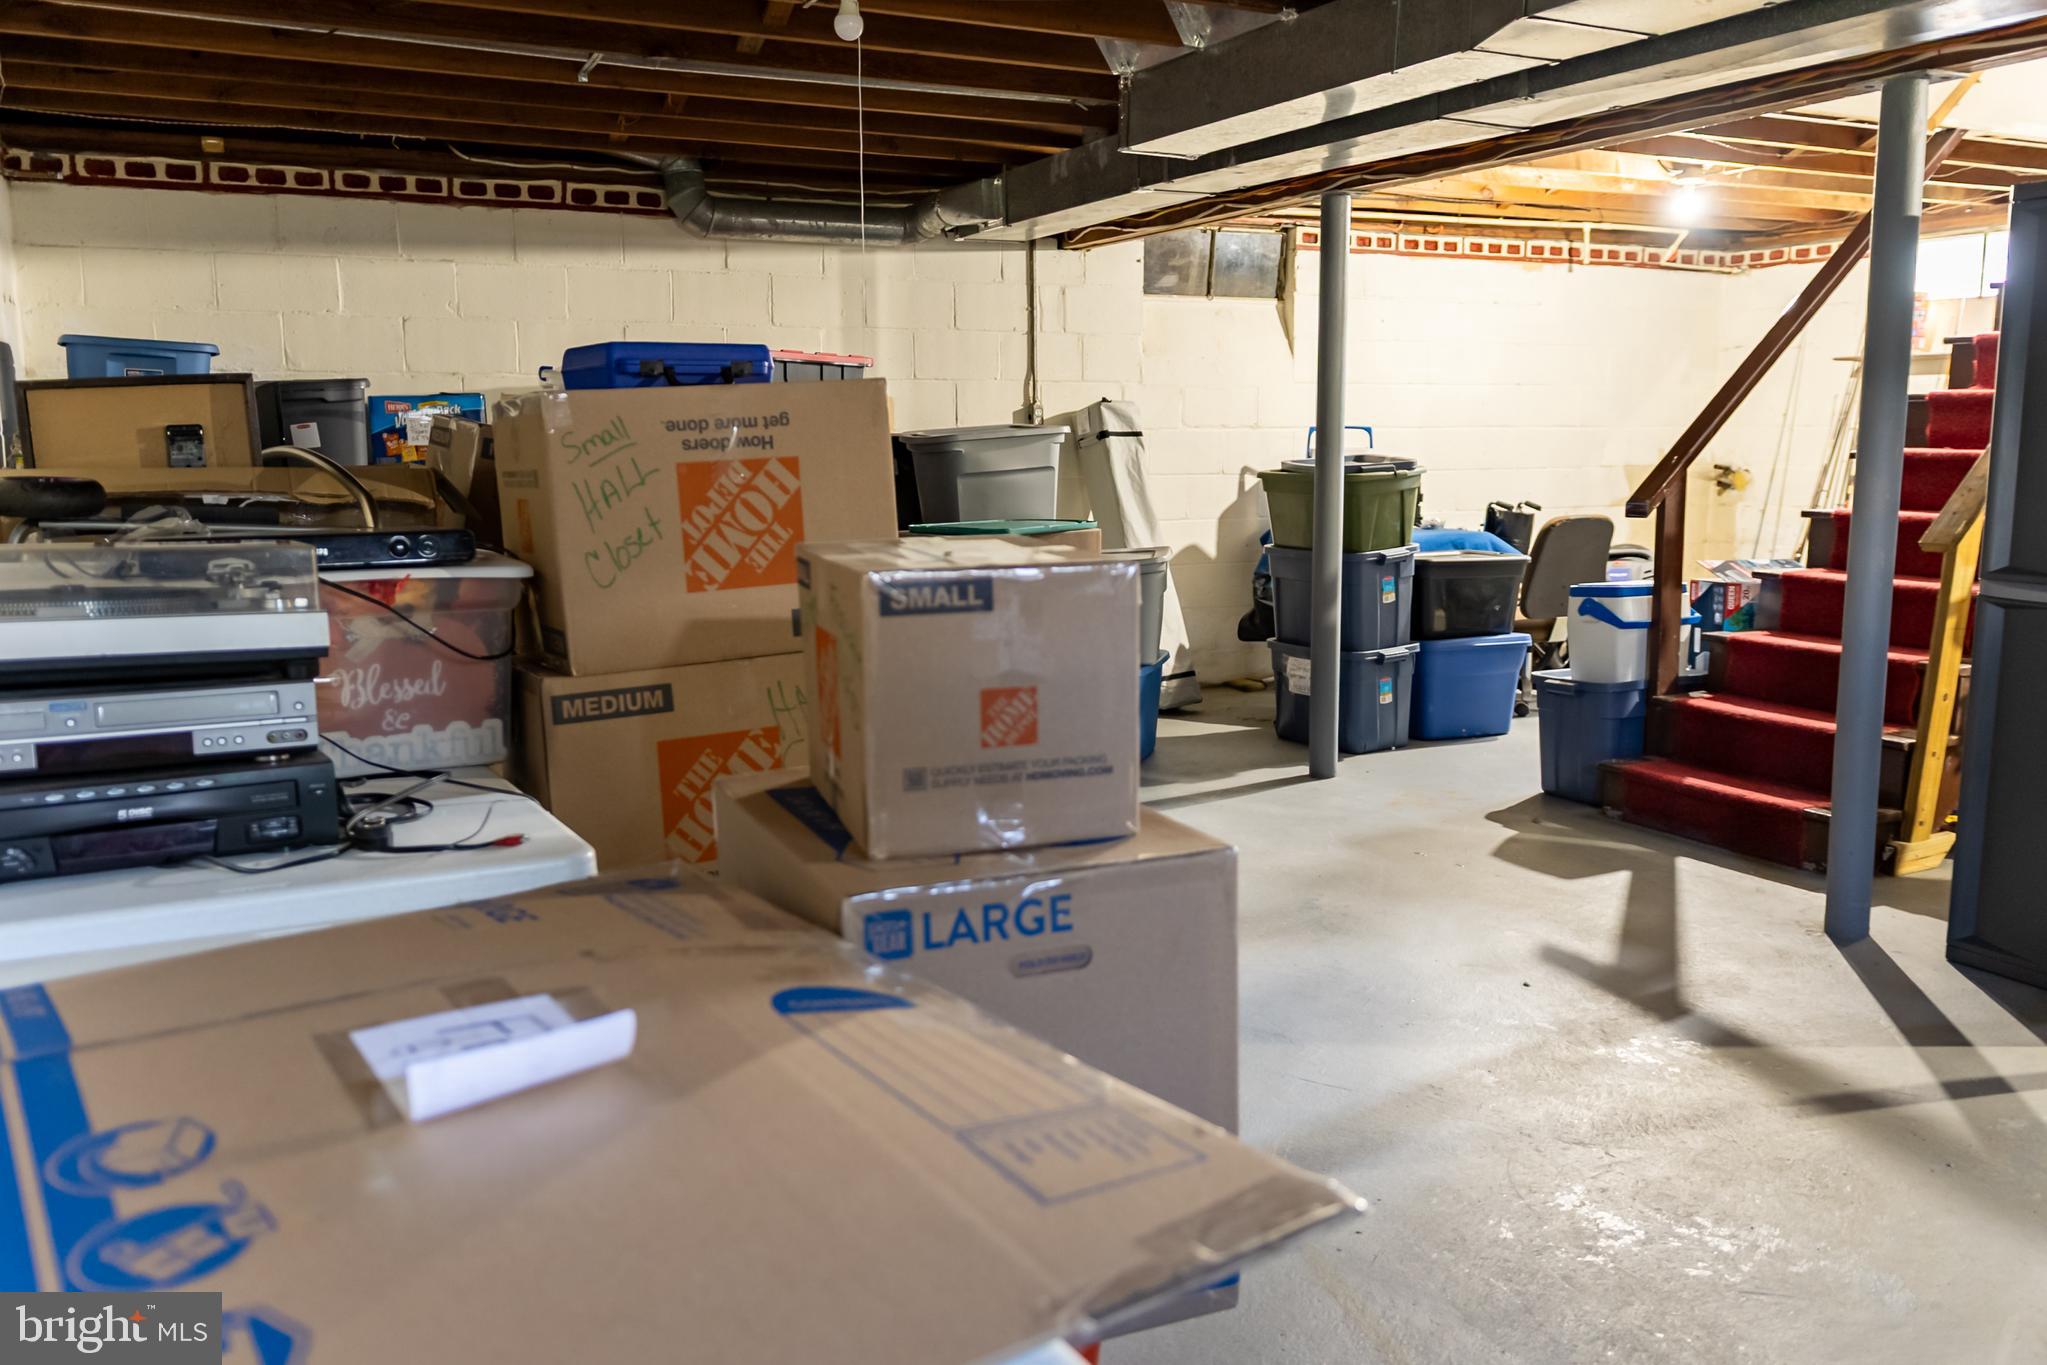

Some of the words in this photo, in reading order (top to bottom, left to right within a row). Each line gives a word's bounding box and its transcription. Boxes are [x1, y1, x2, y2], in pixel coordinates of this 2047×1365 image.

[561, 416, 631, 464] Small
[715, 416, 758, 431] more
[736, 435, 774, 450] How
[763, 411, 790, 427] get
[682, 437, 730, 452] doers
[572, 457, 660, 534] HALL
[682, 460, 753, 545] DEPOT
[585, 507, 663, 589] Closet
[683, 457, 800, 592] HOME
[745, 522, 794, 574] THE
[890, 584, 984, 611] SMALL
[1727, 586, 1736, 610] QUEEN
[328, 660, 447, 710] Blessed
[562, 690, 664, 719] MEDIUM
[673, 748, 723, 800] THE
[923, 893, 1073, 950] LARGE
